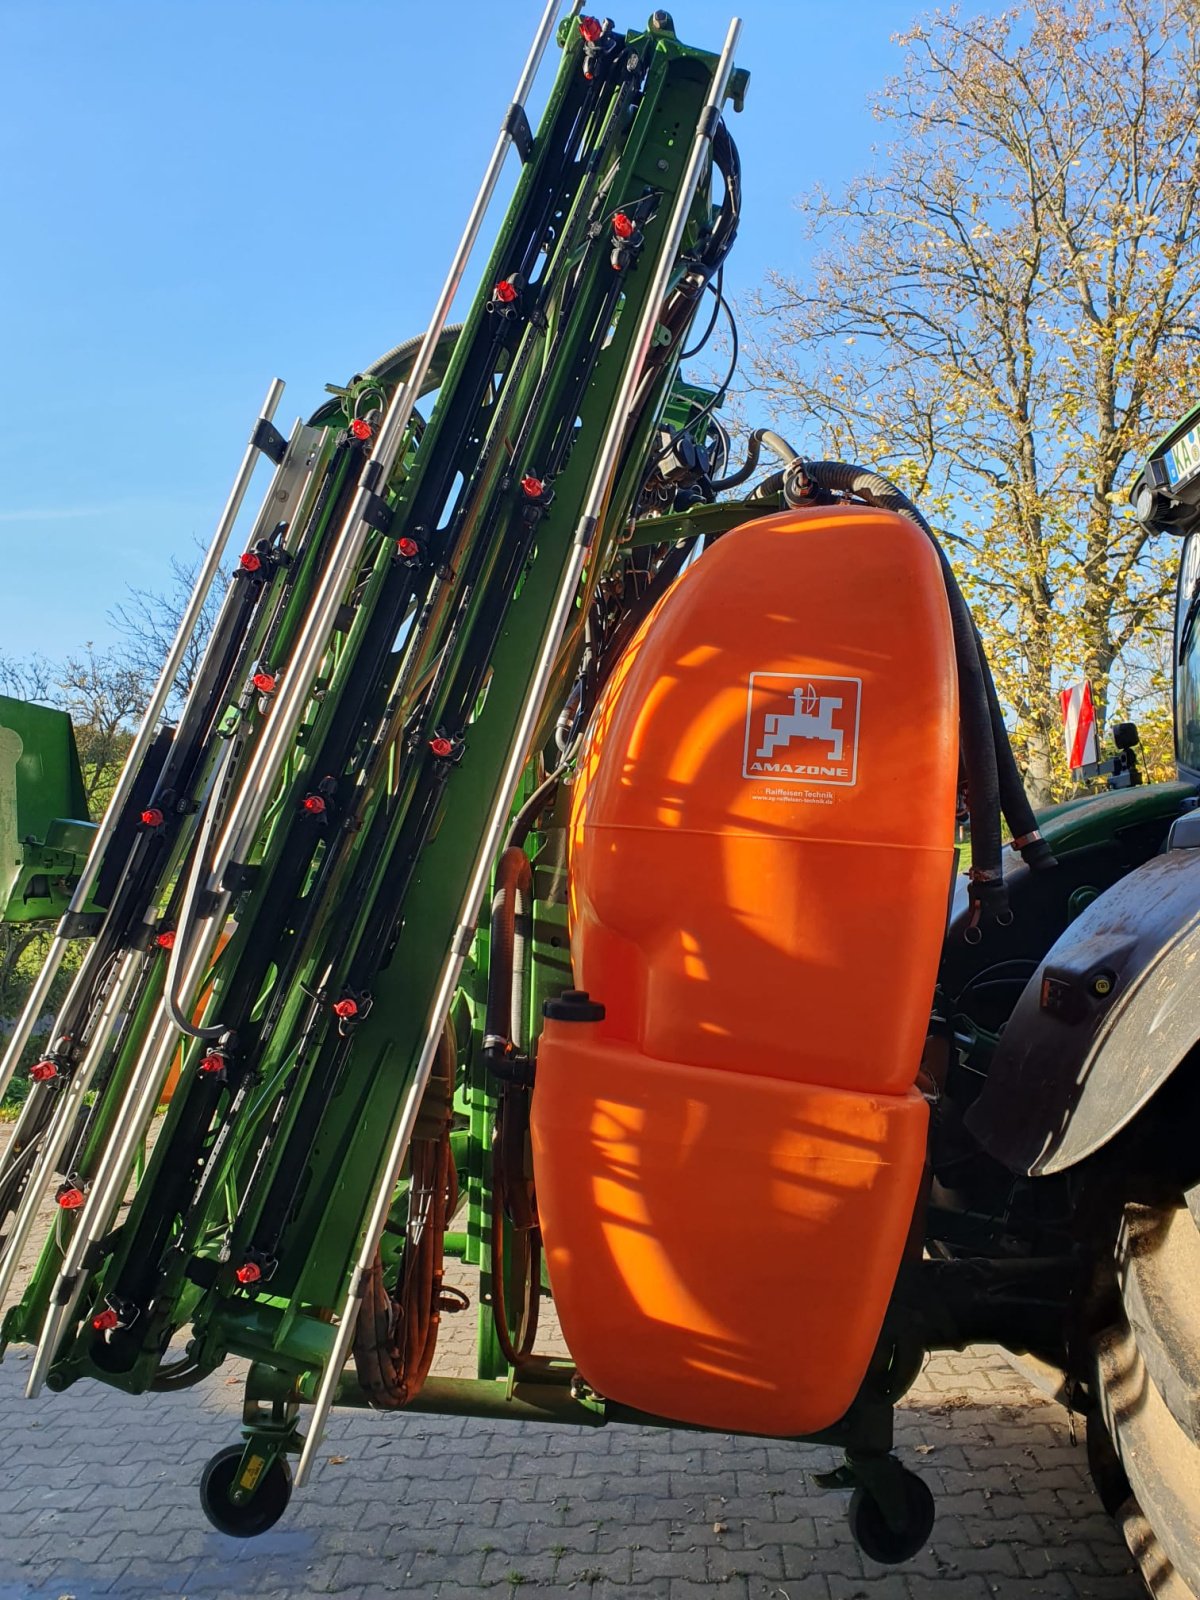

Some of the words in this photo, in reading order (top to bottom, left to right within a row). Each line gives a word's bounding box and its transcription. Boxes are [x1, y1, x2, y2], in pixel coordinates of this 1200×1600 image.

[1173, 440, 1192, 474] KA
[750, 762, 848, 777] AMAZONE
[765, 787, 803, 797] Raiffeisen
[805, 790, 833, 799] Technik
